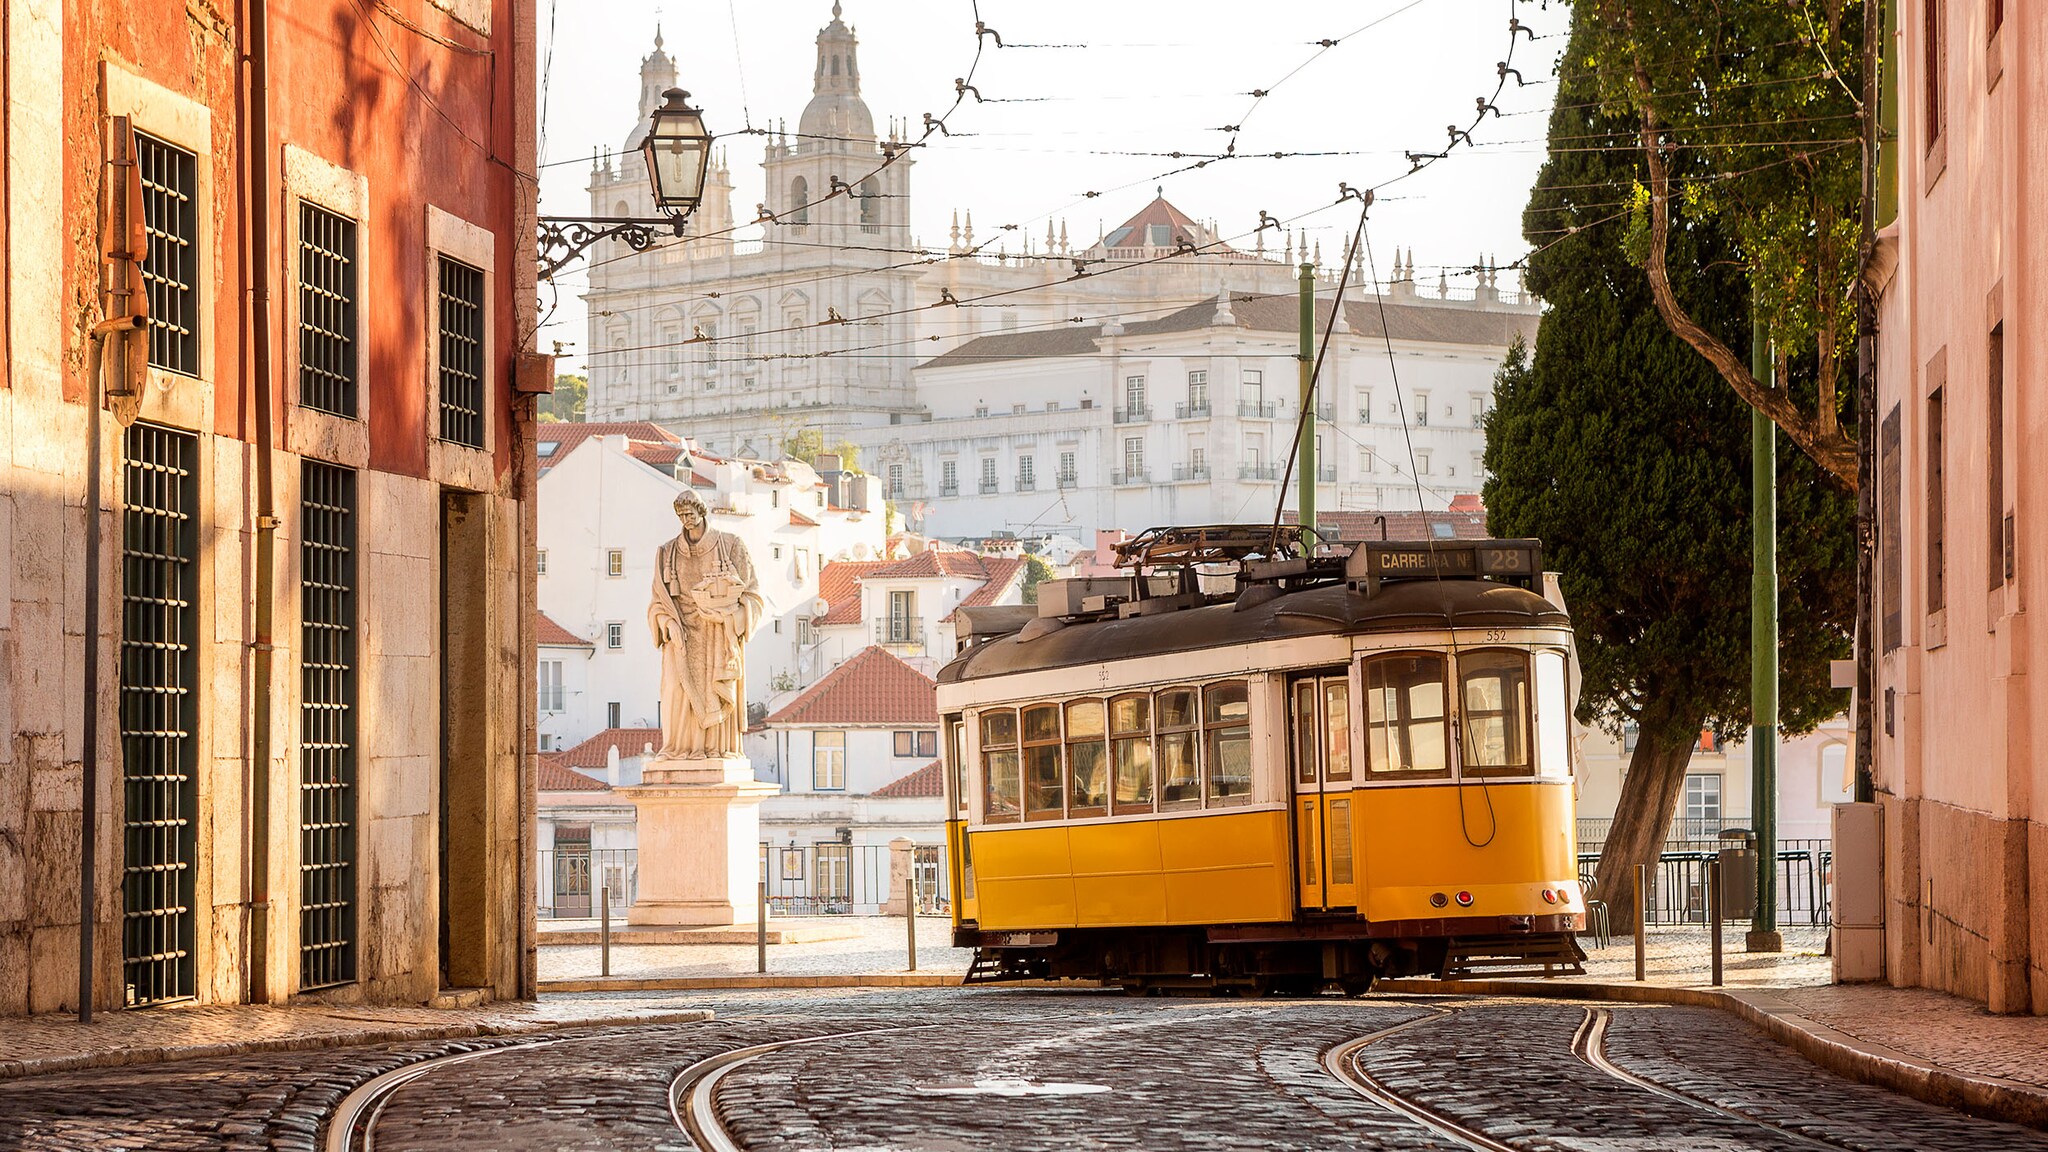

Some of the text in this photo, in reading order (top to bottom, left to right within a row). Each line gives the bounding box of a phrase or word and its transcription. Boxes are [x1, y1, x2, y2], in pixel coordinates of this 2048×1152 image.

[1490, 549, 1520, 570] 28
[1486, 629, 1506, 641] 552
[1098, 670, 1109, 681] 552
